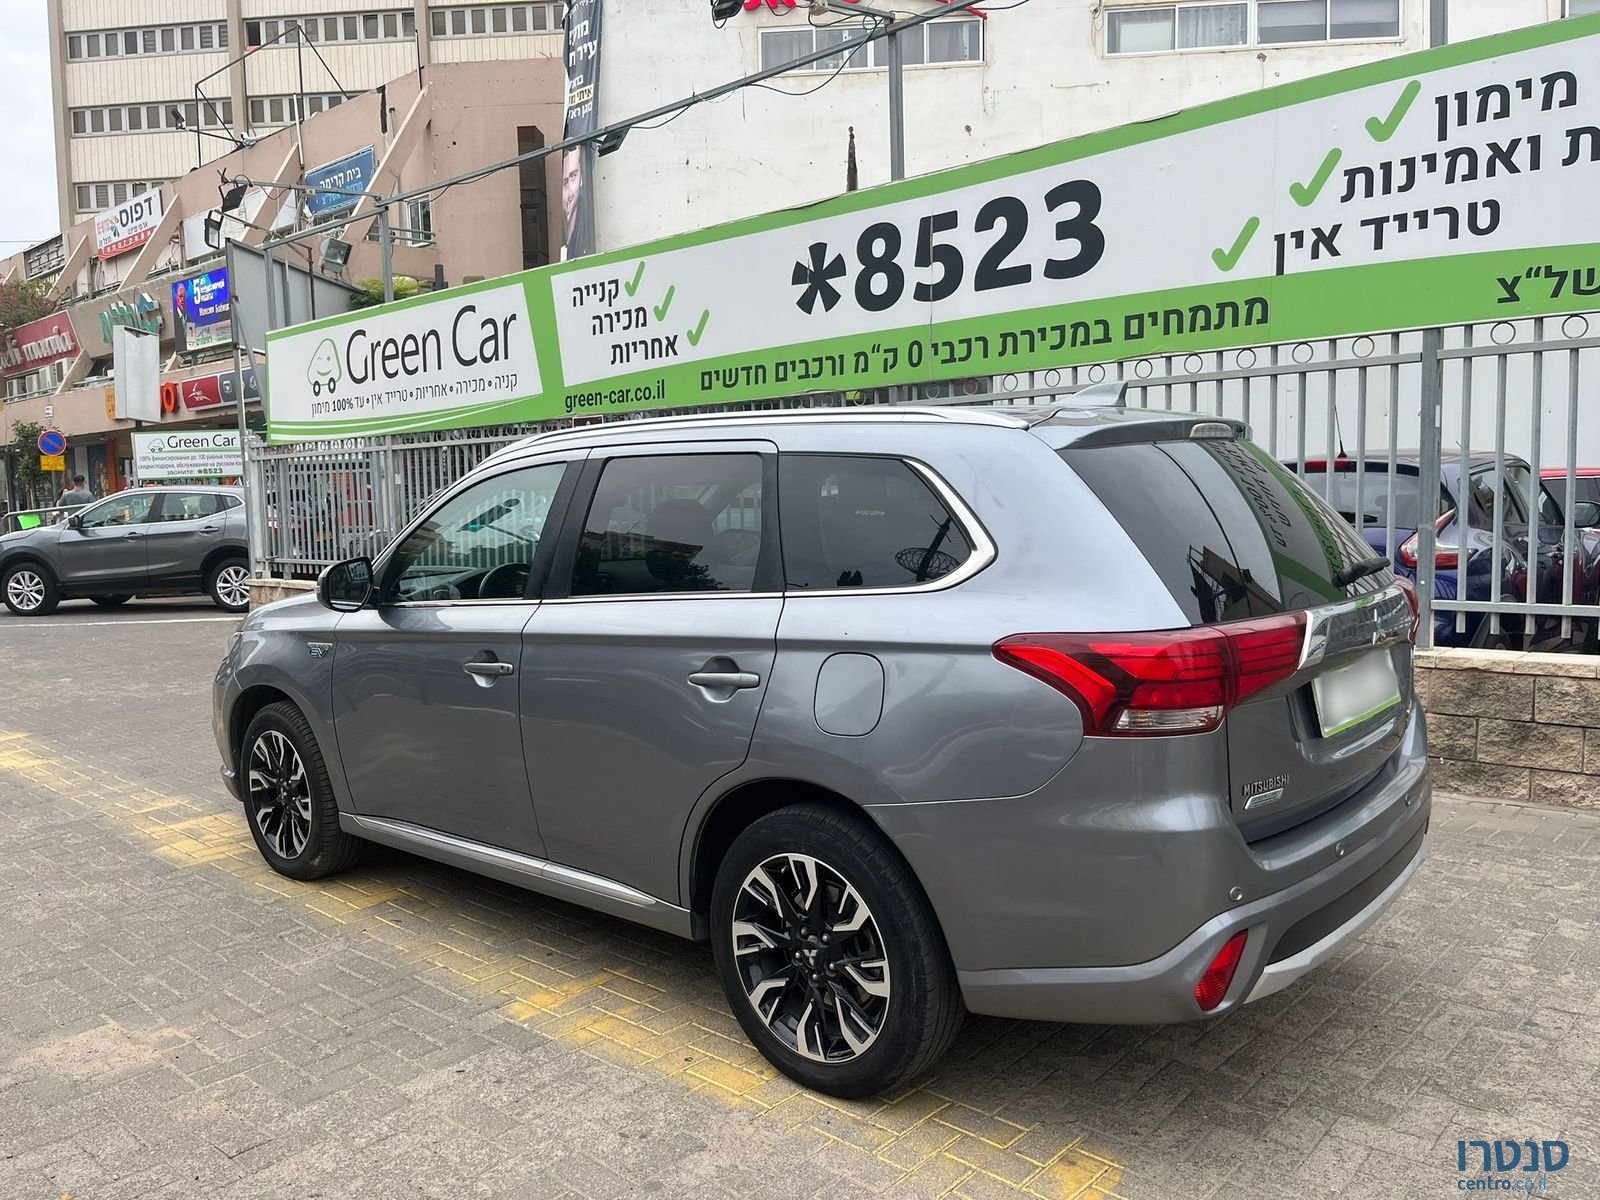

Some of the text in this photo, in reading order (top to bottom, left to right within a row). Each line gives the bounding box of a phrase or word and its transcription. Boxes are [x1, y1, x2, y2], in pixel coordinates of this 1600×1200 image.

[1434, 70, 1578, 142] מימון
[320, 173, 345, 189] קדימה
[346, 167, 361, 182] בית
[1340, 134, 1542, 203] ואמינות
[119, 196, 153, 228] דפוס
[1273, 199, 1501, 276] טרייד אין
[572, 278, 620, 307] קנייה
[591, 307, 648, 336] מכירה
[1123, 296, 1270, 341] מתמחים
[346, 304, 518, 385] Green Car
[610, 334, 679, 366] אחריות
[907, 339, 923, 368] 0
[939, 333, 990, 366] רכבי
[998, 317, 1113, 359] במכירת
[700, 361, 767, 392] חדשים
[775, 353, 845, 383] ורכבים
[311, 373, 518, 418] קניה מכירה אחריות טרייד אין עד 100% מימון
[564, 379, 666, 413] green-car.co.il
[167, 434, 236, 449] Green Car
[1243, 773, 1289, 796] MITSUBISHI
